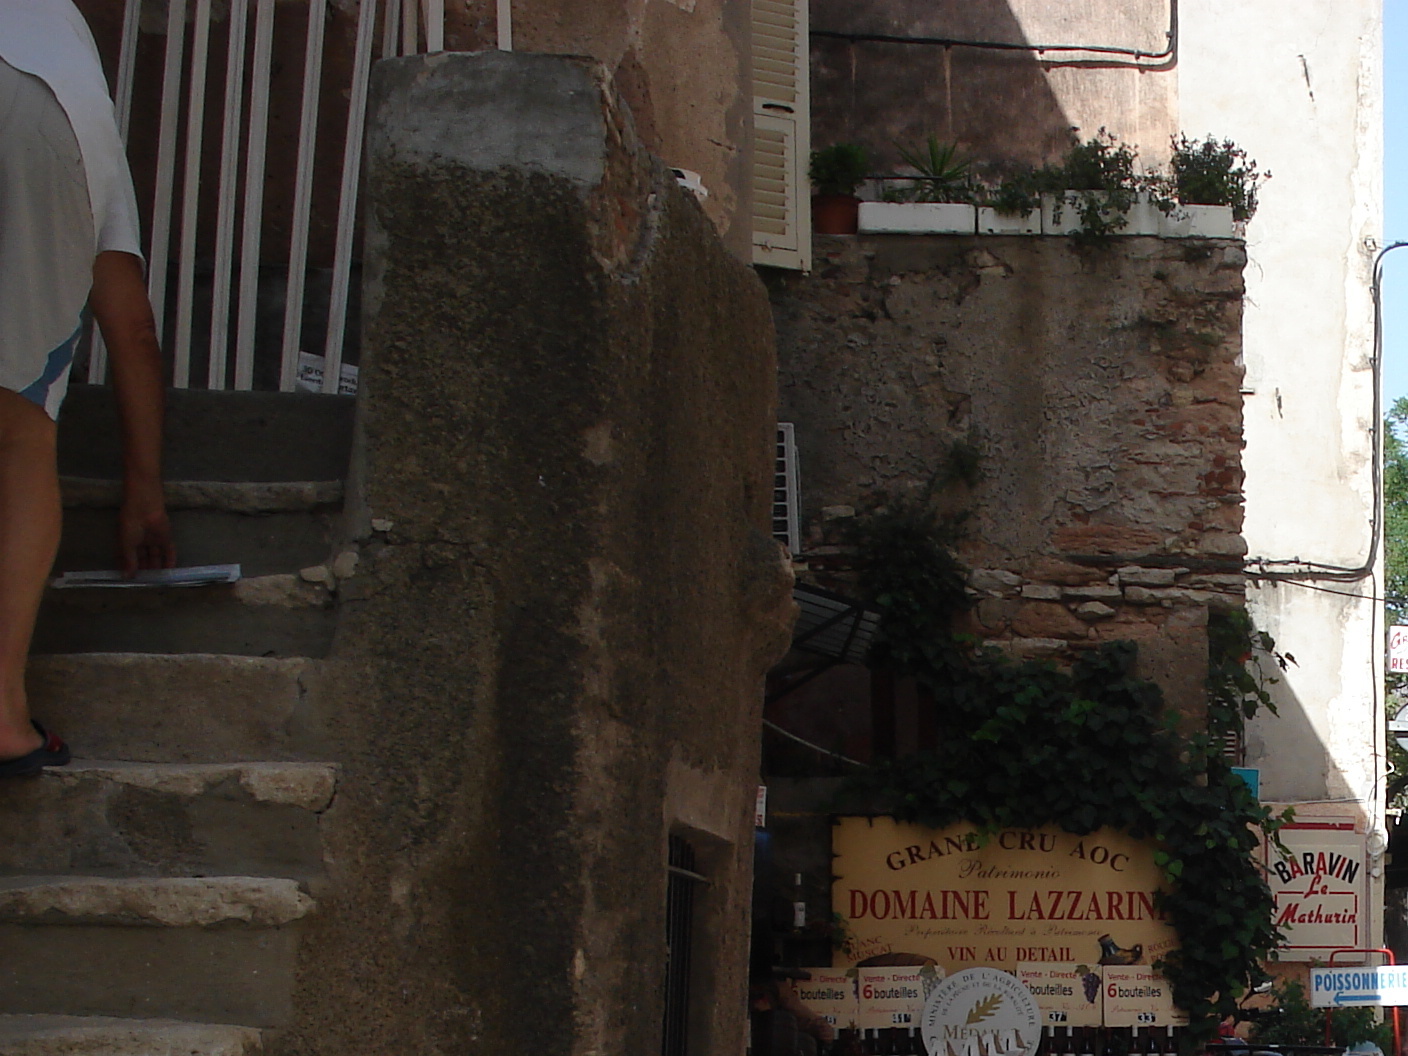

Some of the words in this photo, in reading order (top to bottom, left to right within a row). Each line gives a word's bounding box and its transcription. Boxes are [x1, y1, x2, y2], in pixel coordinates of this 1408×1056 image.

[999, 831, 1057, 853] CRU
[1069, 840, 1130, 872] AOC
[958, 858, 1060, 880] Patrimonio
[1273, 851, 1359, 885] BARAVIN
[1303, 874, 1328, 899] Le
[848, 889, 990, 920] DOMAINE
[1277, 903, 1357, 925] Mathurin
[947, 946, 976, 962] VIN
[984, 946, 1007, 962] AU
[1016, 946, 1075, 962] DETAIL
[961, 972, 975, 982] DE
[1020, 970, 1042, 978] Vente
[1107, 973, 1131, 981] Vente
[1314, 971, 1408, 992] POISSONNERIE
[862, 984, 873, 1000] 6
[874, 987, 918, 999] bouteilles
[1029, 984, 1073, 997] bouteilles
[1107, 983, 1117, 998] 6
[1118, 984, 1162, 998] bouteilles
